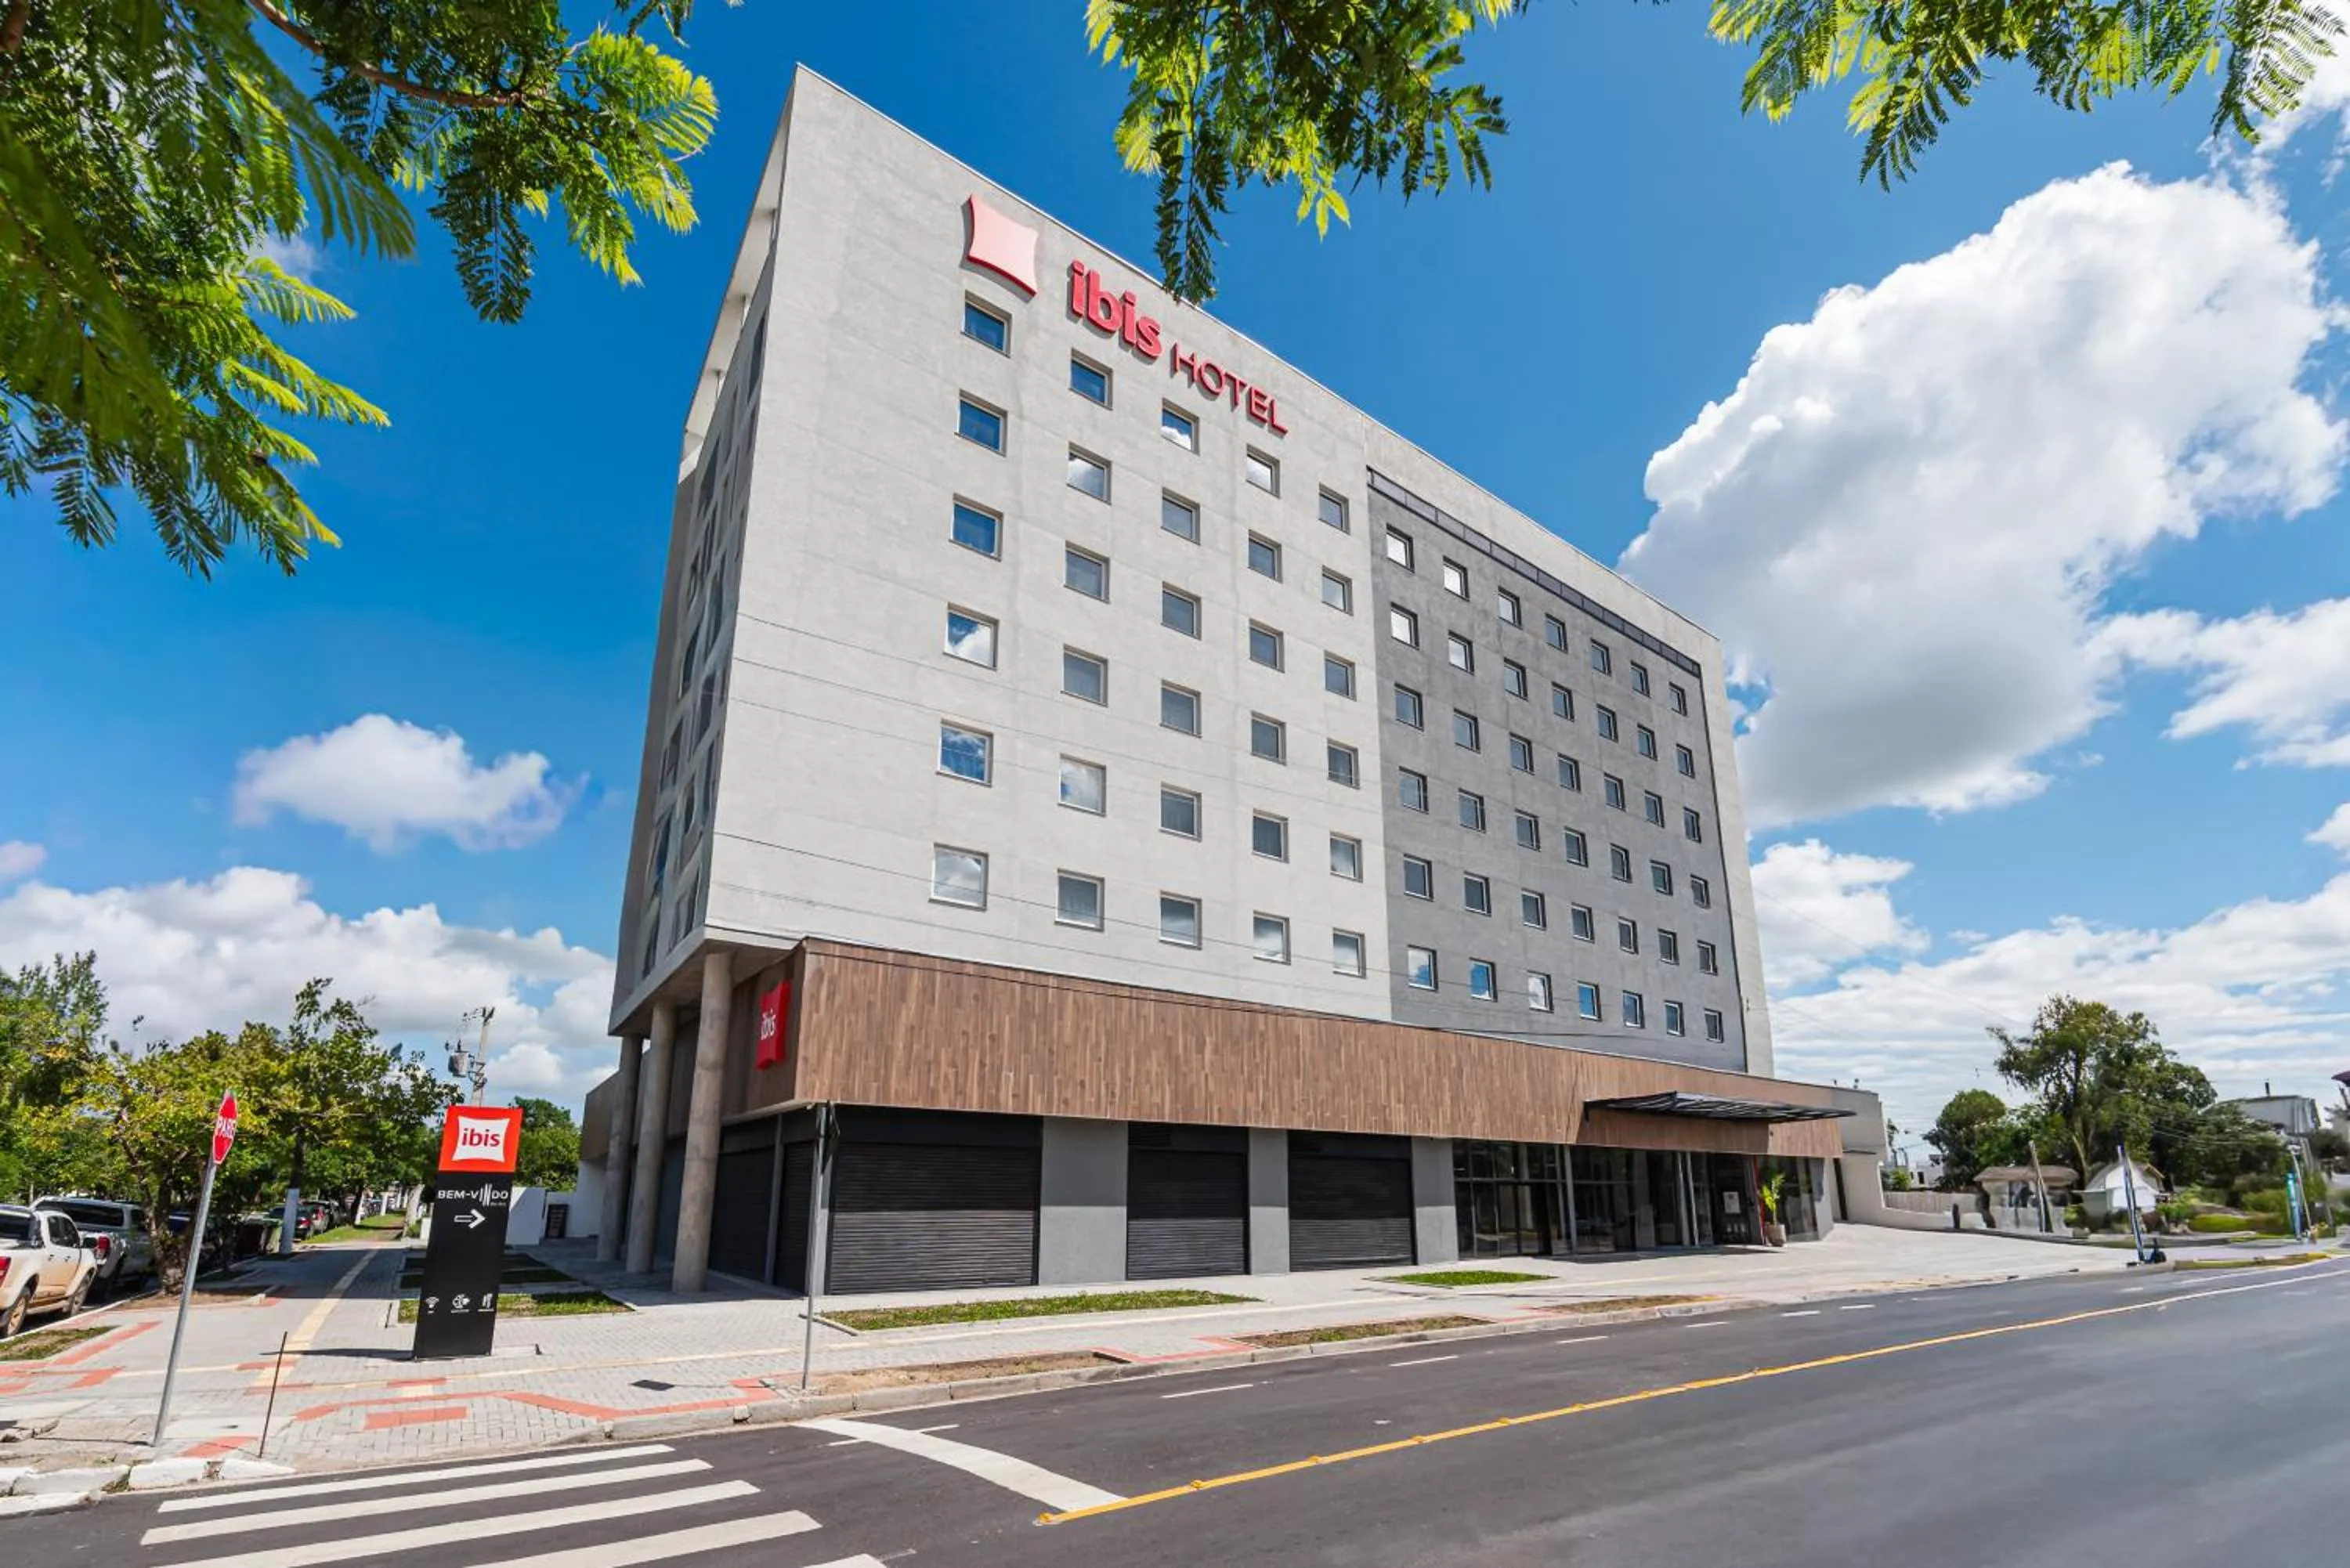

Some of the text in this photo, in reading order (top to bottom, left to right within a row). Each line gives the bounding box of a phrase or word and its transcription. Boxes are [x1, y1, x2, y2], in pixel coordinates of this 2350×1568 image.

[1069, 259, 1289, 435] ibis HOTEL
[462, 1128, 501, 1147] ibis
